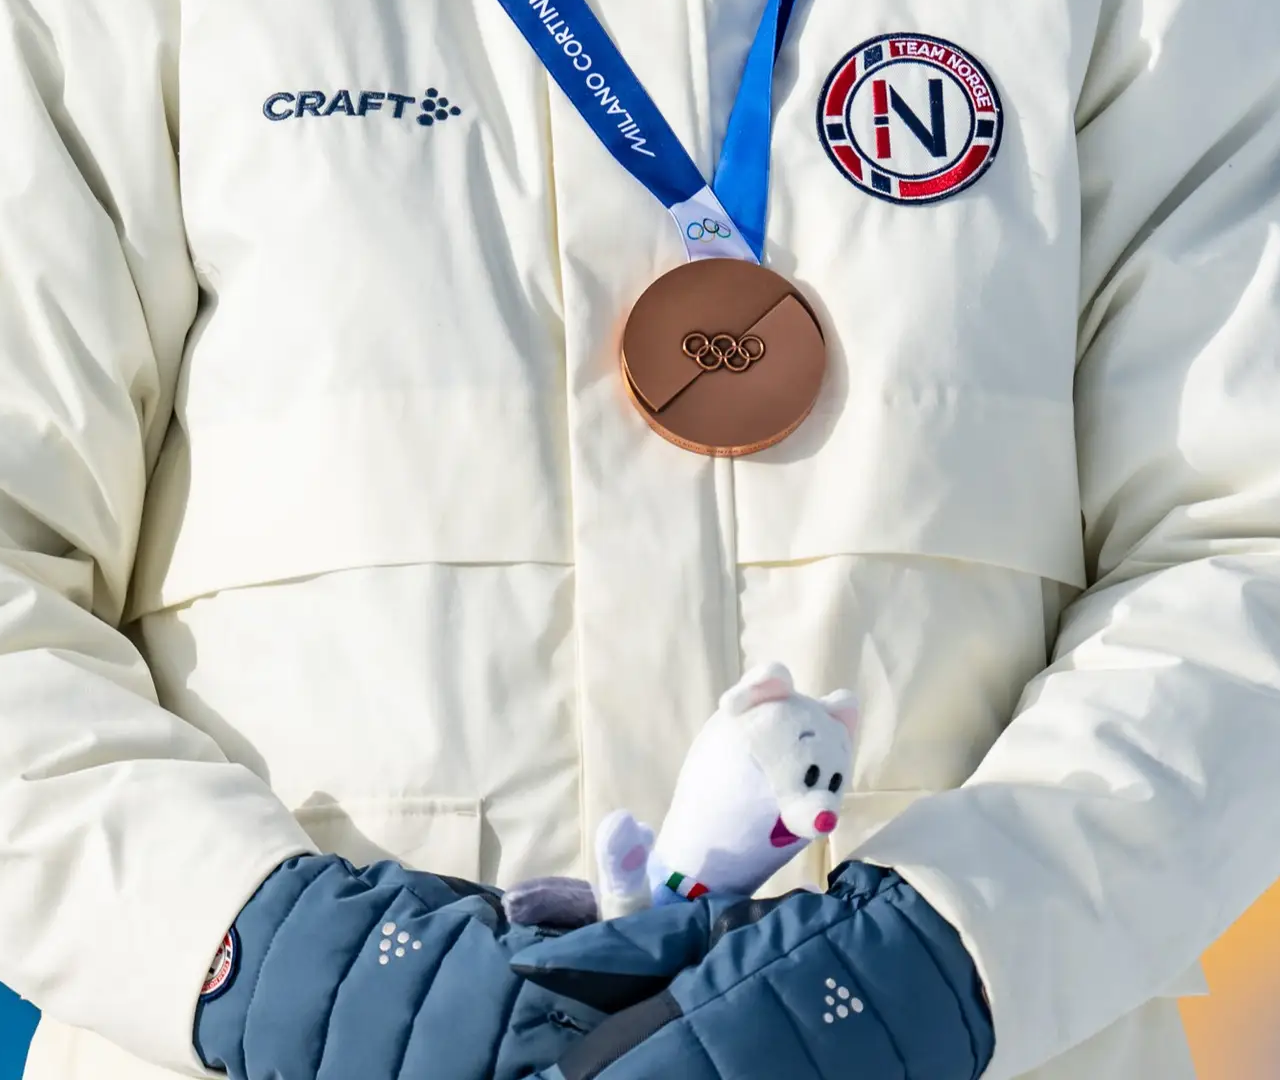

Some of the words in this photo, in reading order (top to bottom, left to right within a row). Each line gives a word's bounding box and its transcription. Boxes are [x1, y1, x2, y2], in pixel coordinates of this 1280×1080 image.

[262, 89, 416, 121] CRAFT
[895, 42, 946, 61] TEAM
[947, 55, 993, 108] NORGE
[586, 73, 656, 157] MILANO
